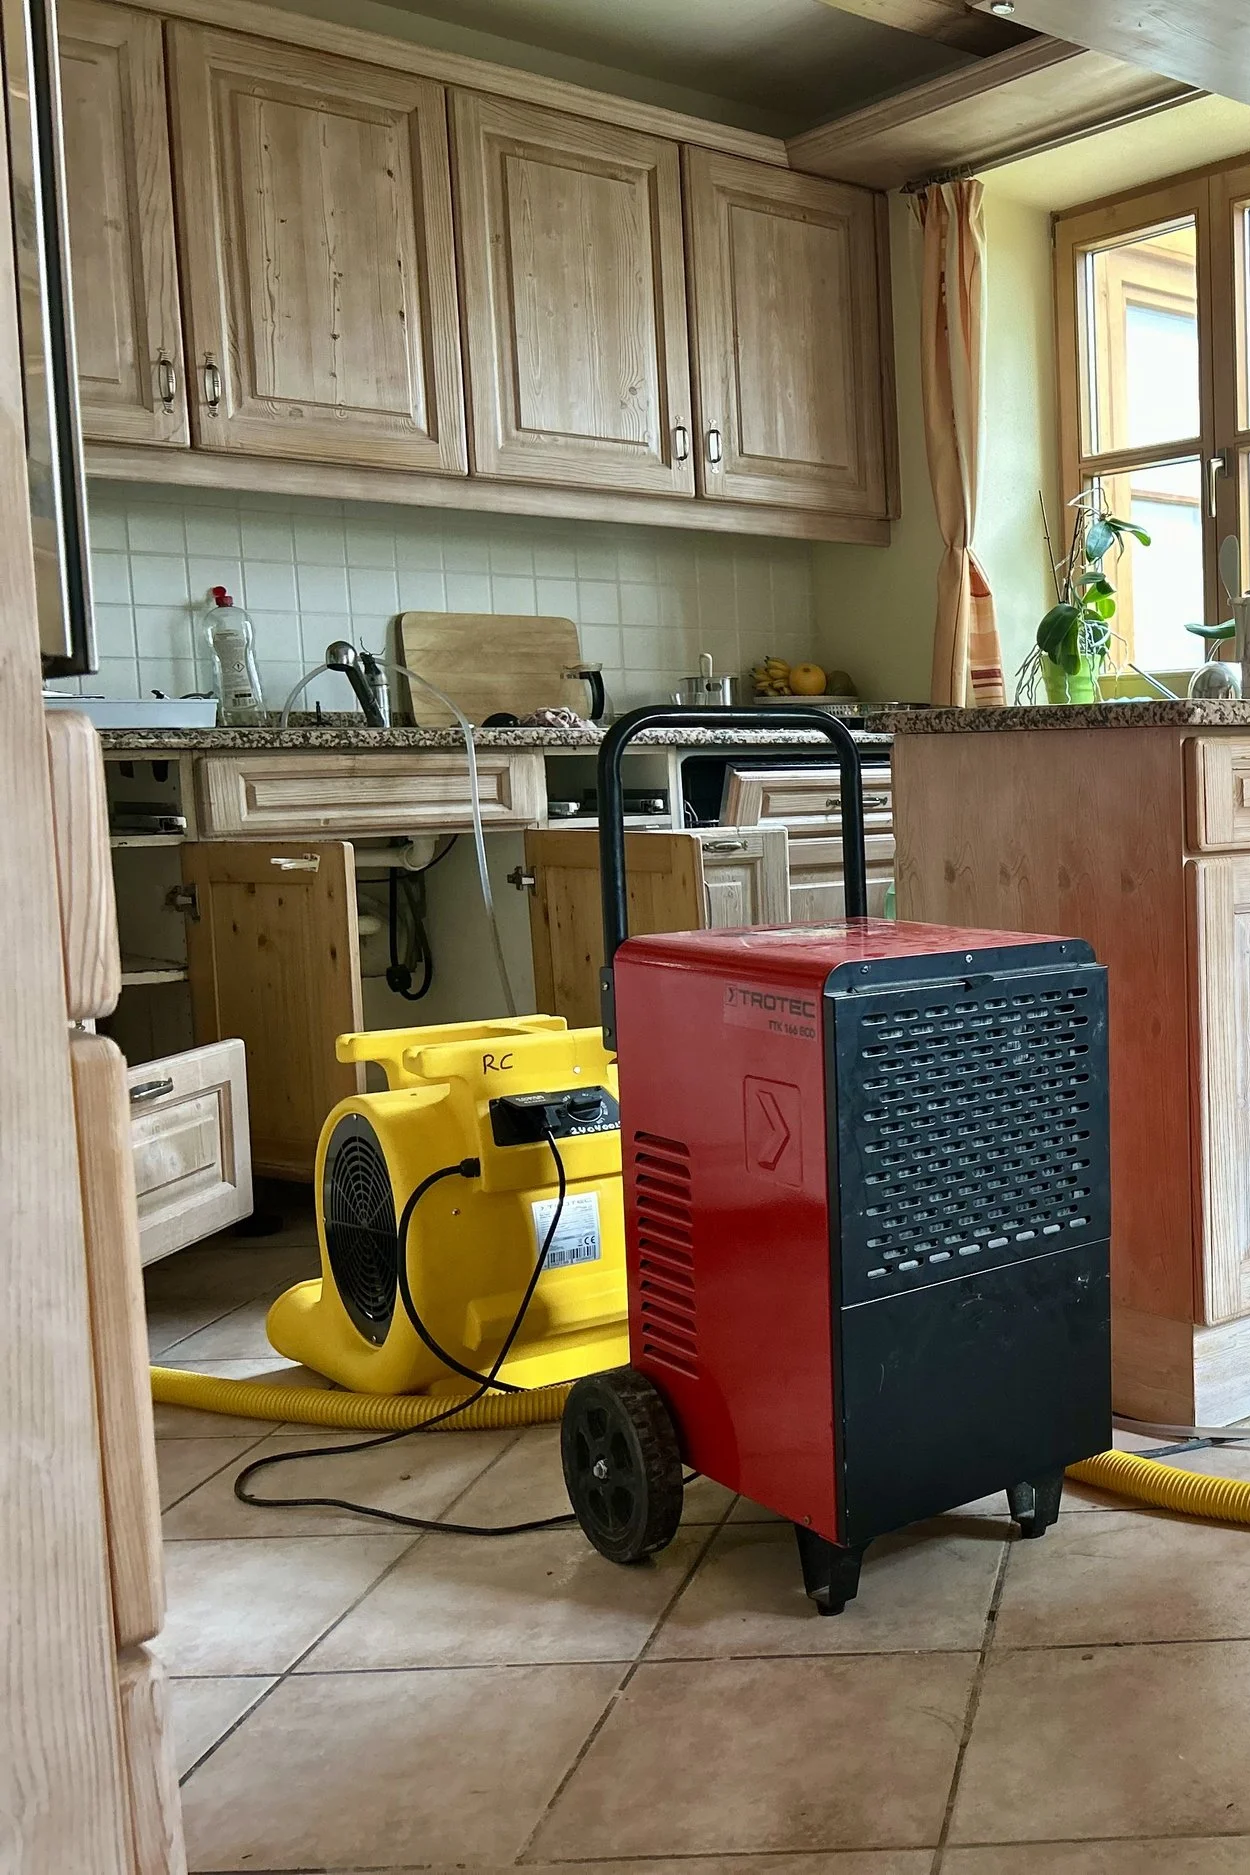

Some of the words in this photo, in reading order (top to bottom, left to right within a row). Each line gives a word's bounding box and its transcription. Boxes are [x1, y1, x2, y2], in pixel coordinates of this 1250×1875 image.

[739, 989, 816, 1019] TROTEC
[768, 1020, 782, 1032] TTK
[784, 1023, 798, 1036] 166
[799, 1027, 816, 1039] ECO
[482, 1053, 513, 1075] RC
